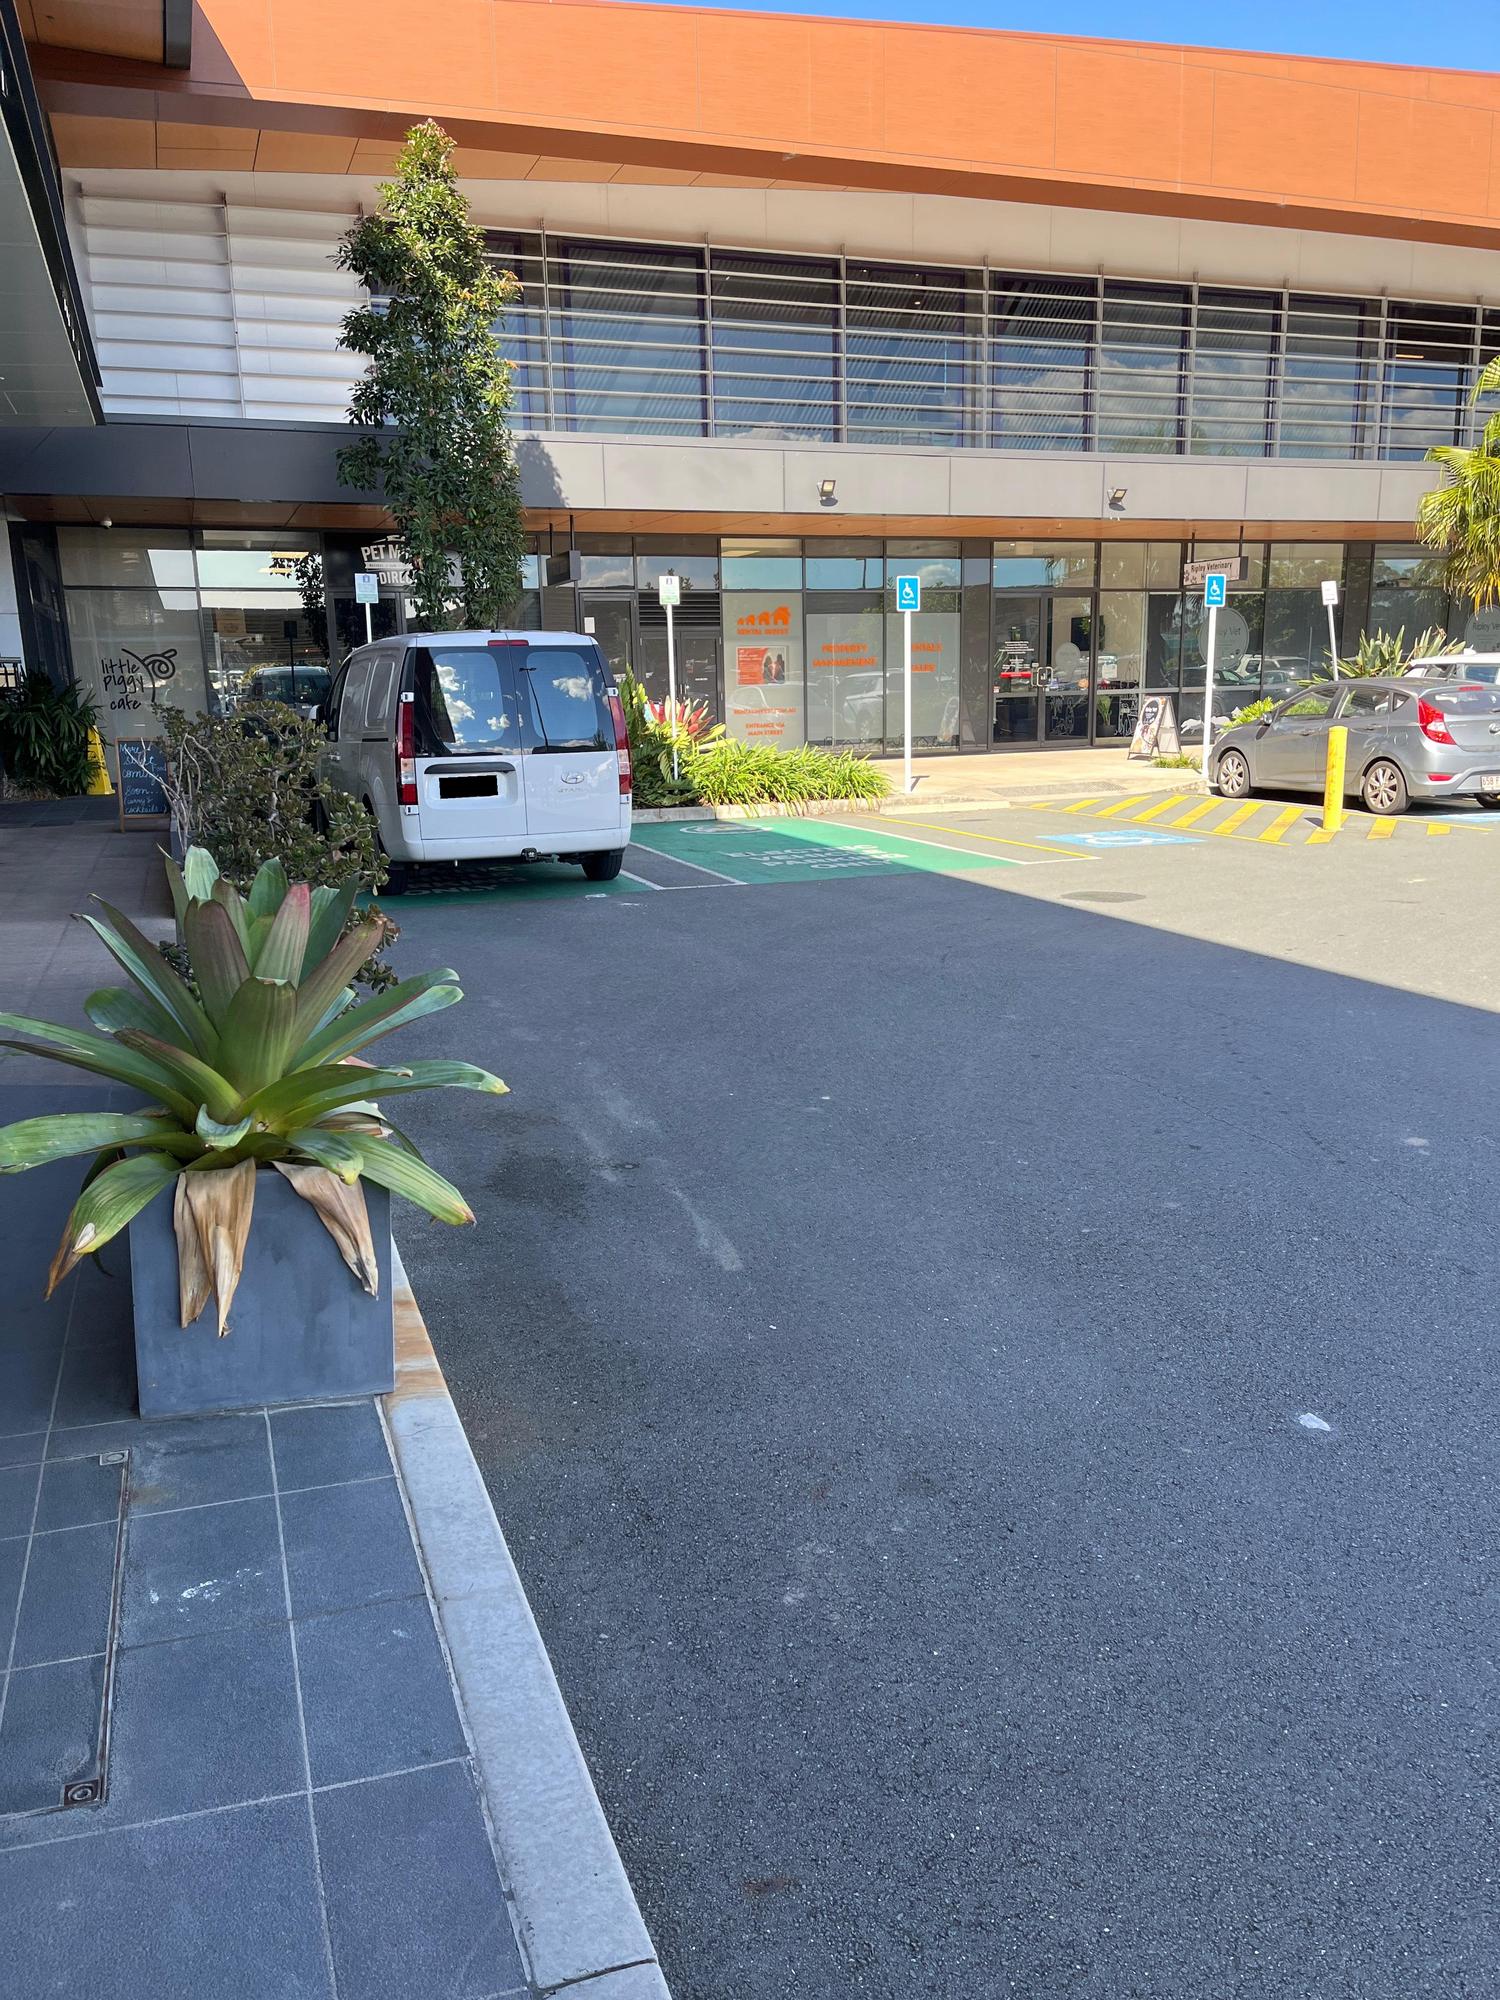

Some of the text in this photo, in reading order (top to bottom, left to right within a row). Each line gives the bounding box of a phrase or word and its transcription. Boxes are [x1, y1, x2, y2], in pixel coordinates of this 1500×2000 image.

[361, 544, 386, 561] PET
[1191, 561, 1233, 573] Ripley Veterinary
[379, 570, 418, 585] DIREC
[101, 658, 140, 674] little
[103, 674, 144, 694] piggy
[110, 694, 141, 710] cafe
